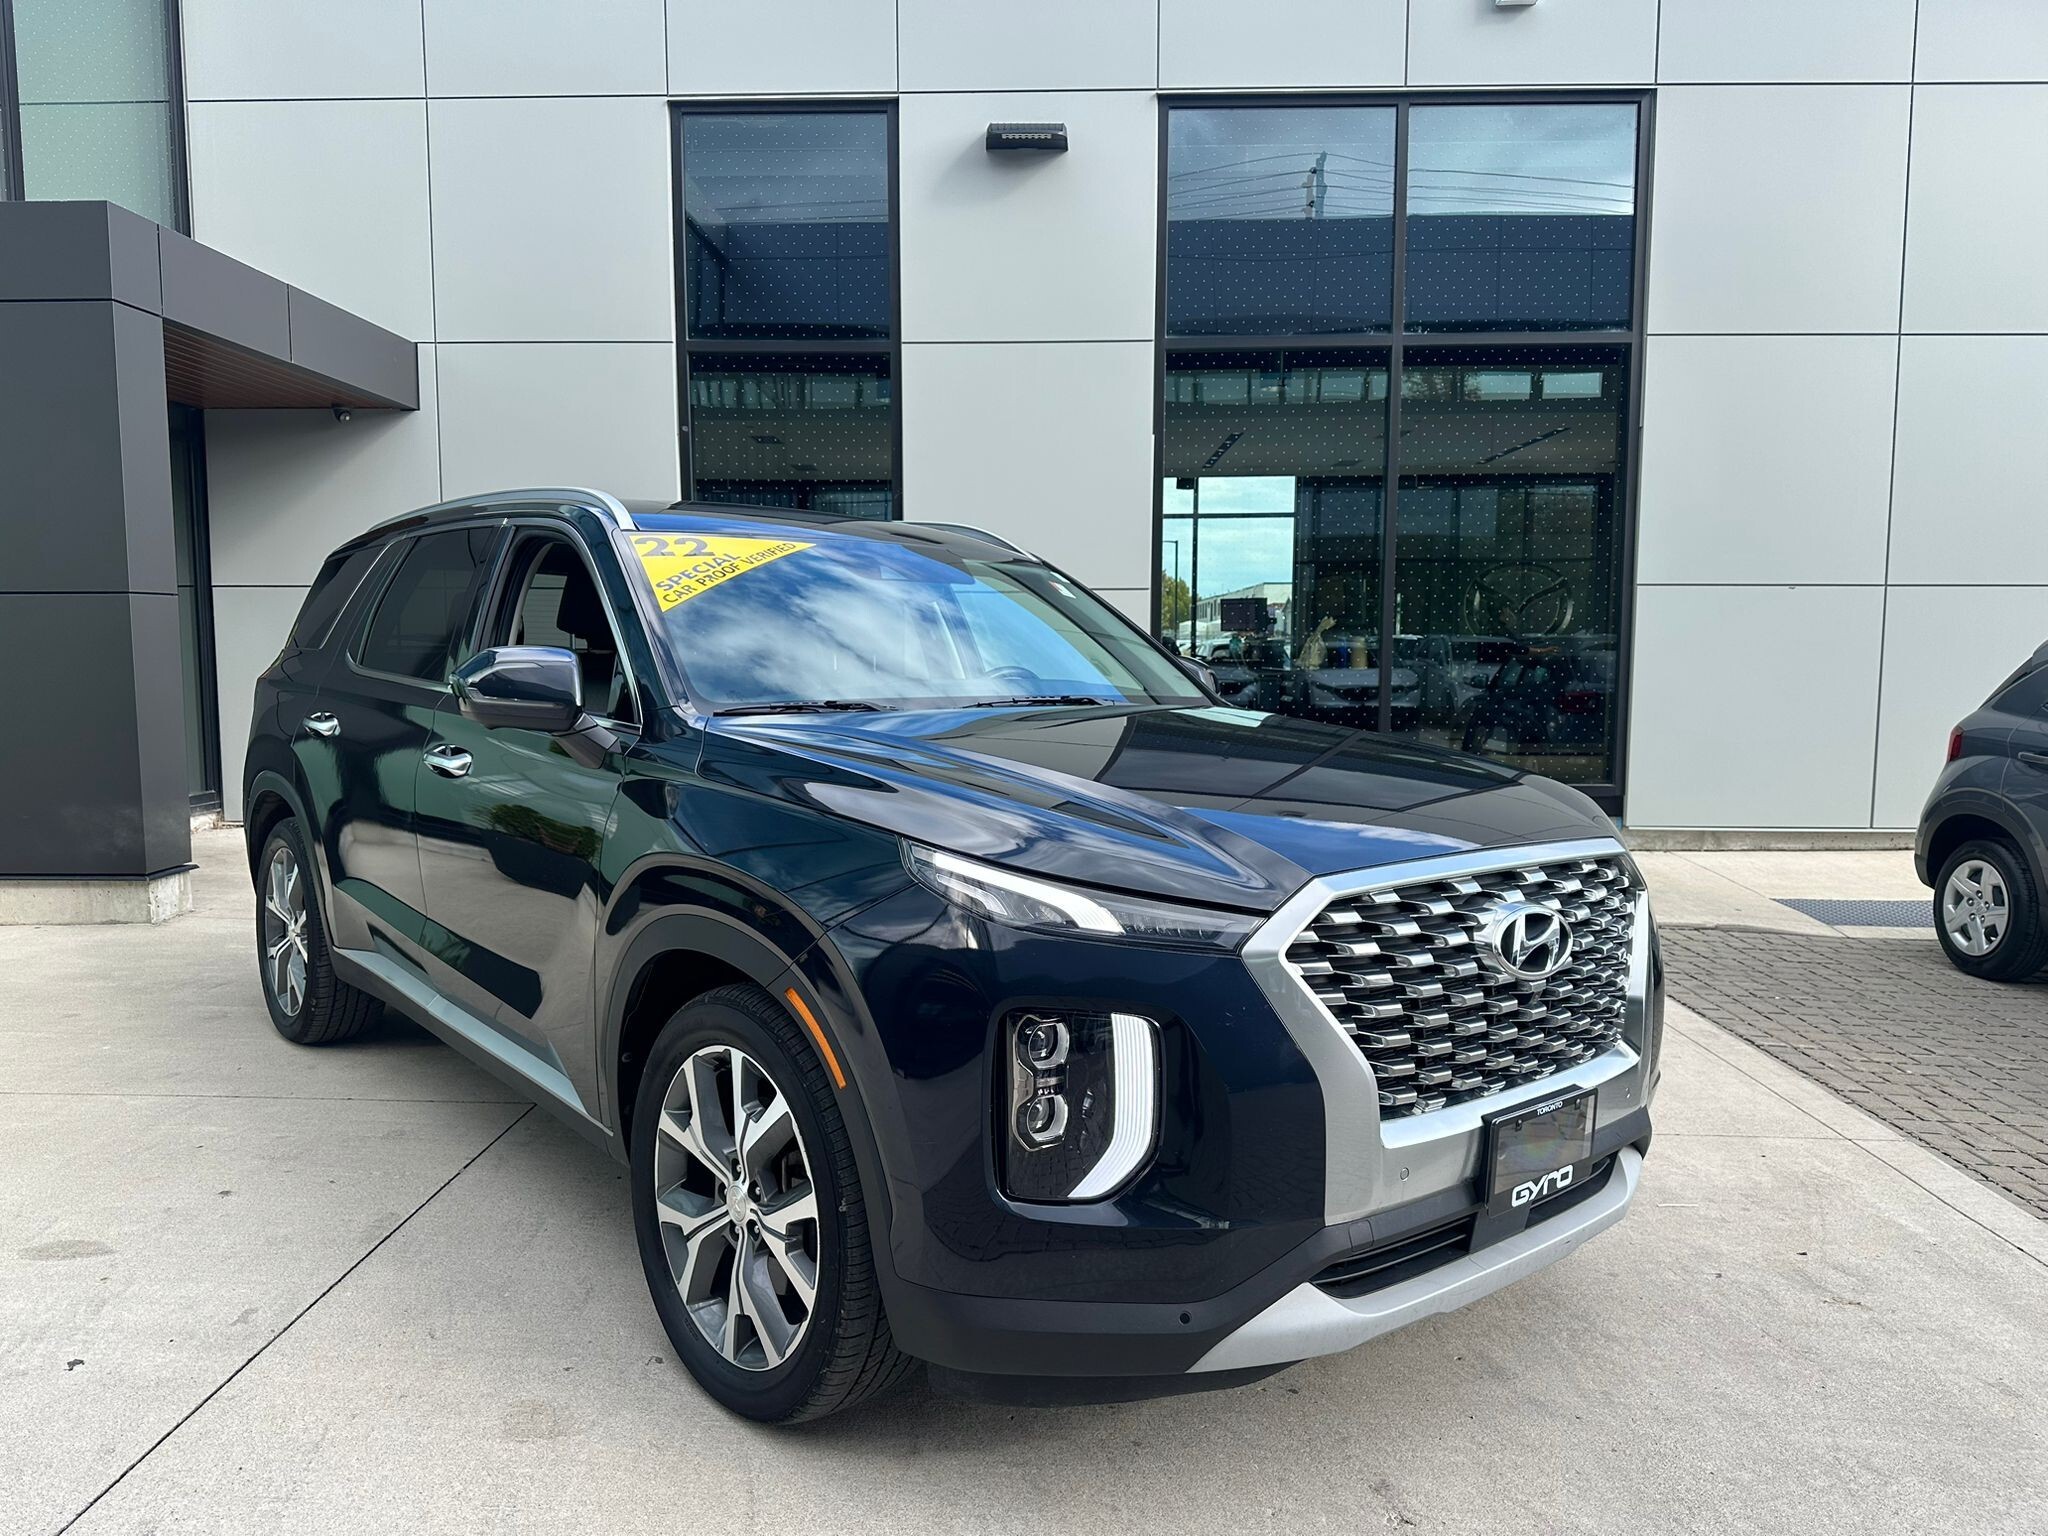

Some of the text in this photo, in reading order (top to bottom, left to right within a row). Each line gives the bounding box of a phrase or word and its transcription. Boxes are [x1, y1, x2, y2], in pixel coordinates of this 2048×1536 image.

[634, 537, 715, 557] 22
[656, 553, 741, 592] SPECIAL
[662, 543, 797, 604] CAR PROOF VERIFIED
[1537, 1101, 1563, 1116] TORONTO
